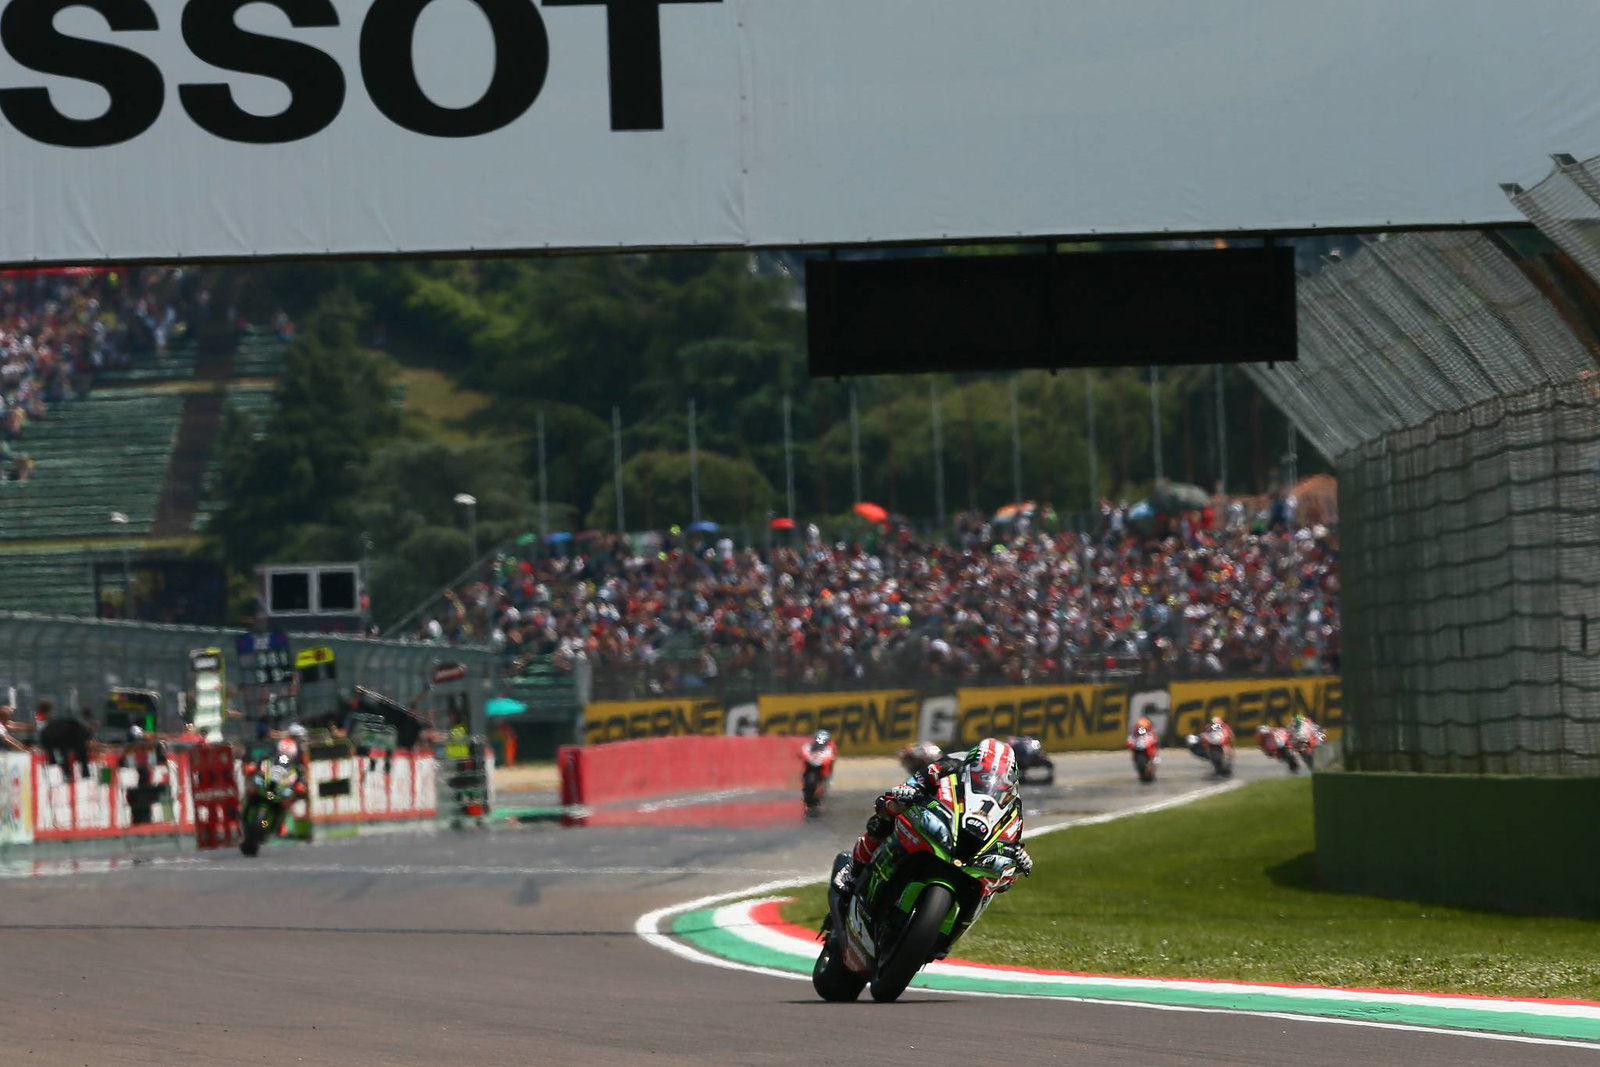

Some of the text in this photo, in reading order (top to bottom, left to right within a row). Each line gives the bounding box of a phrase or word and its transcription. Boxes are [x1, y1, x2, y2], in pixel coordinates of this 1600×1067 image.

[0, 0, 722, 148] SSOT
[980, 799, 994, 813] 1
[967, 818, 984, 829] elf
